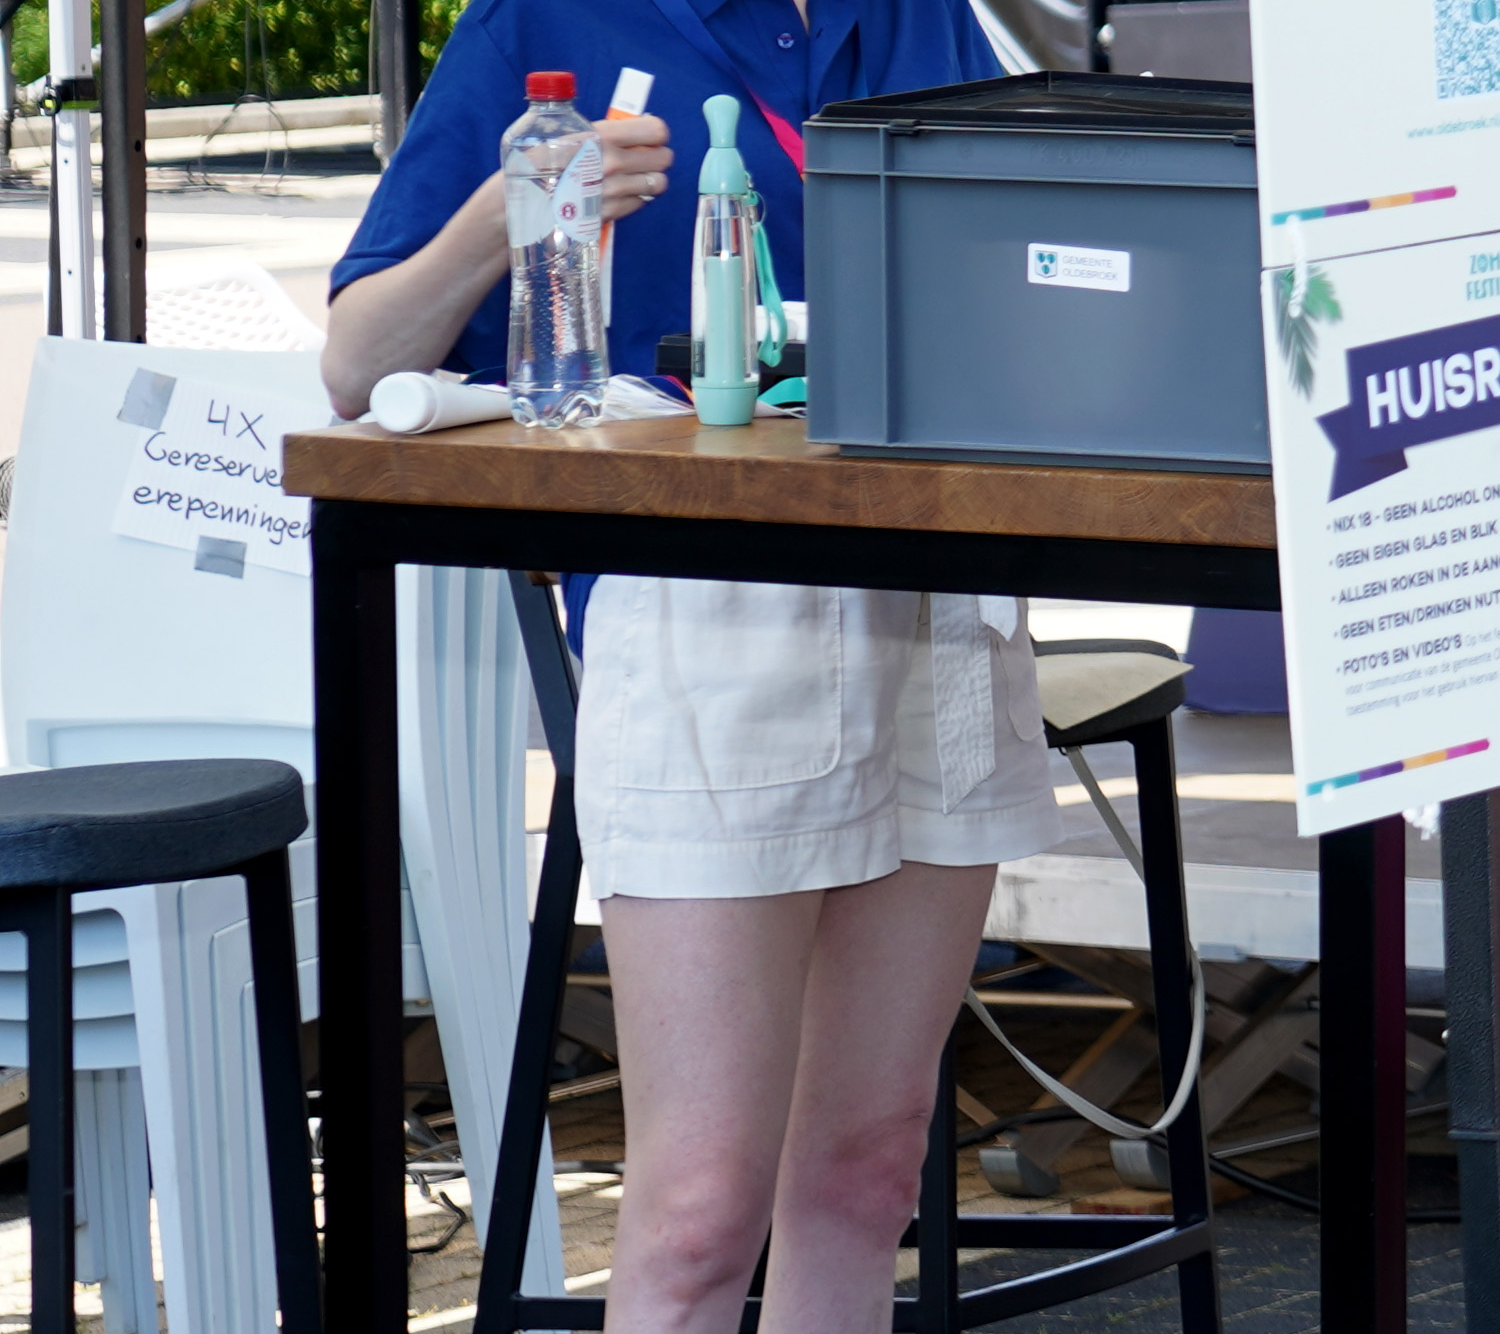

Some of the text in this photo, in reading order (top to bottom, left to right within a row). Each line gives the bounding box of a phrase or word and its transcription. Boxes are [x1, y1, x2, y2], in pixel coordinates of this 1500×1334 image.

[145, 431, 284, 487] Gereserve
[1334, 515, 1356, 532] NIX
[1358, 511, 1372, 527] 18
[1384, 503, 1417, 522] GEEN
[1420, 490, 1480, 514] ALCOHOL
[1336, 549, 1370, 568] GEEN
[1374, 540, 1410, 560] EIGEN
[1414, 531, 1448, 551] GLAS
[1451, 527, 1467, 543] EN
[1470, 520, 1497, 539] BLIK
[1339, 581, 1387, 603] ALLEEN
[1391, 570, 1434, 591] ROKEN
[1438, 566, 1449, 581] IN
[1453, 561, 1469, 578] DE
[1340, 619, 1374, 639] GEEN
[1378, 598, 1471, 631] ETEN/DRINKEN
[1344, 651, 1389, 674] FOTO'S
[1393, 646, 1409, 663] EN
[1412, 634, 1462, 657] VIDEO'S
